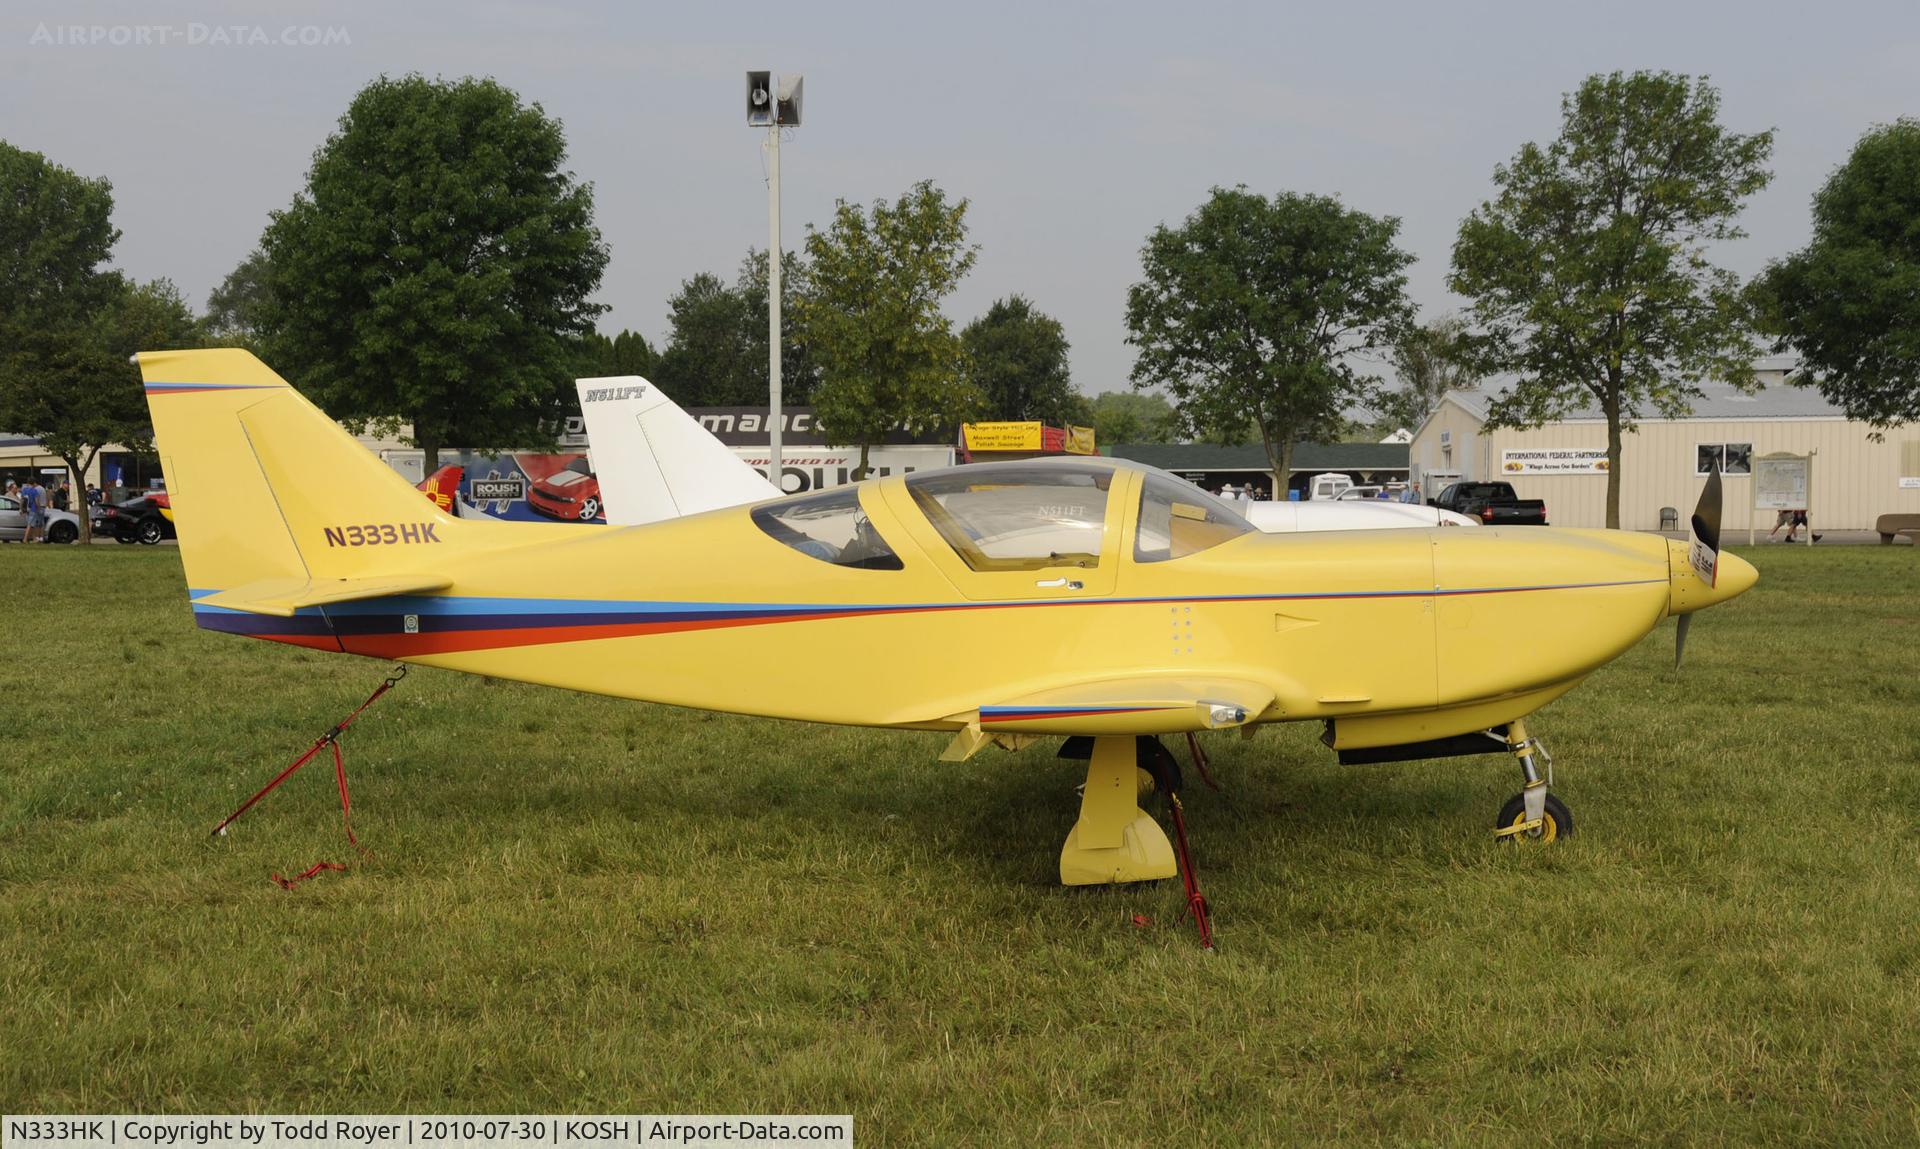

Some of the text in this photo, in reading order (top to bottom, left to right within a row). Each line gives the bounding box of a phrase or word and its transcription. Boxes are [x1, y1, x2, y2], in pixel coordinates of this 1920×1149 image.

[585, 386, 646, 402] N511FT
[1505, 452, 1548, 460] INTERNATIONAL
[1549, 452, 1573, 460] FEDERAL
[477, 484, 520, 493] ROUSH
[324, 523, 441, 547] N333HK
